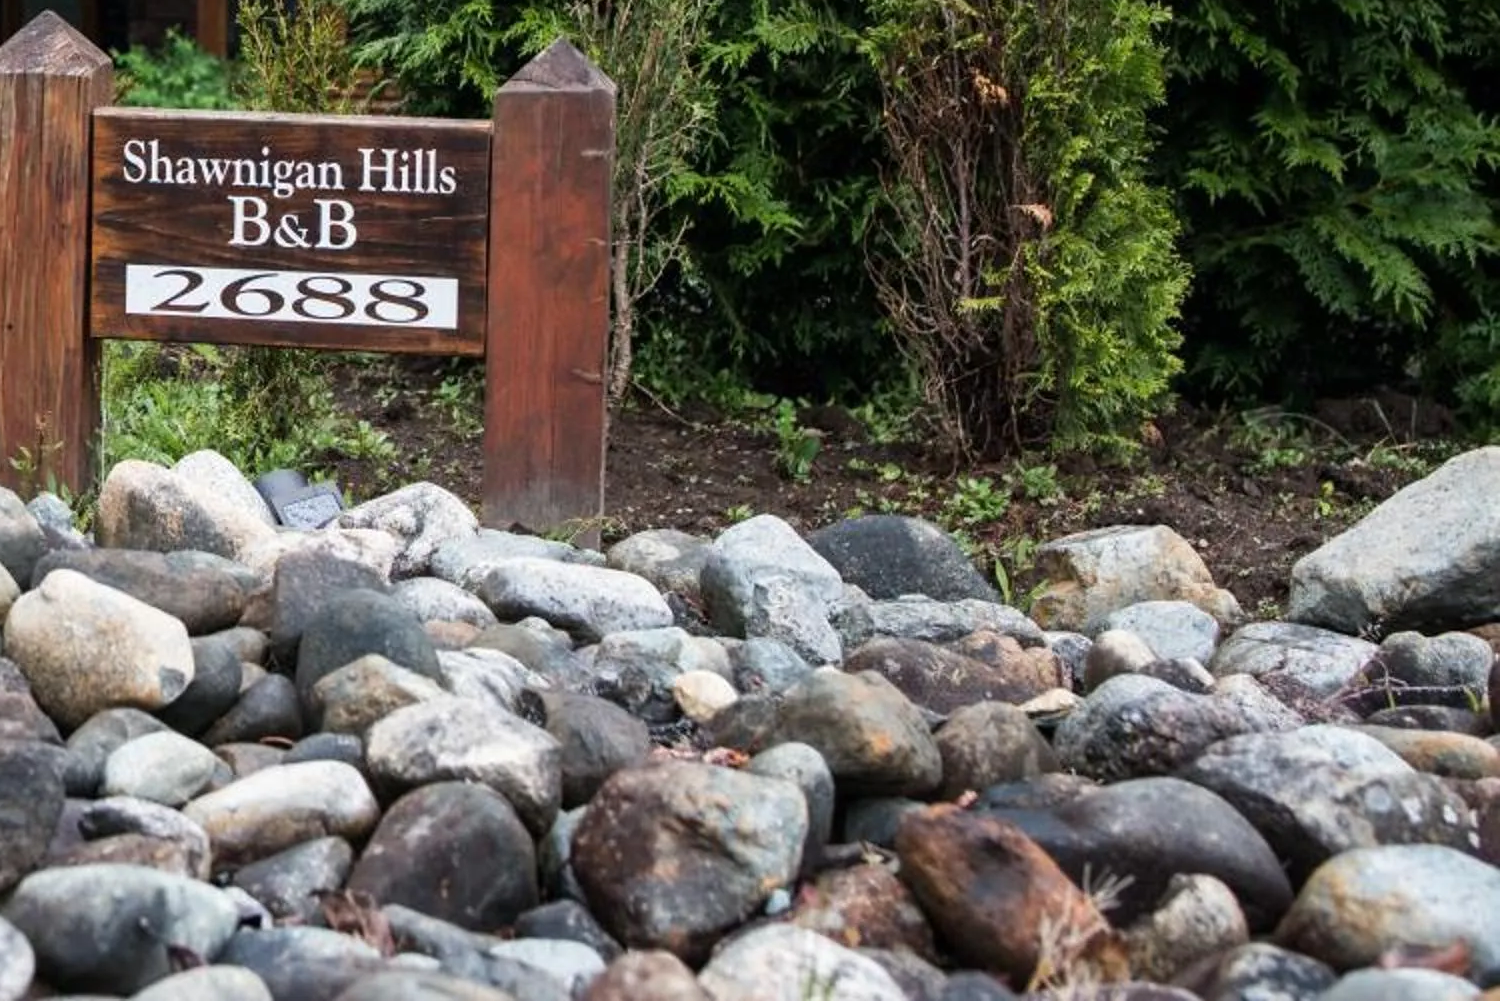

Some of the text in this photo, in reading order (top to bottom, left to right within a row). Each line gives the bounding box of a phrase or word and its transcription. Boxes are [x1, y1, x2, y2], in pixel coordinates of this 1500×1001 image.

[123, 139, 456, 198] Shawnigan Hills
[227, 195, 357, 250] B&B
[150, 269, 429, 323] 2688
